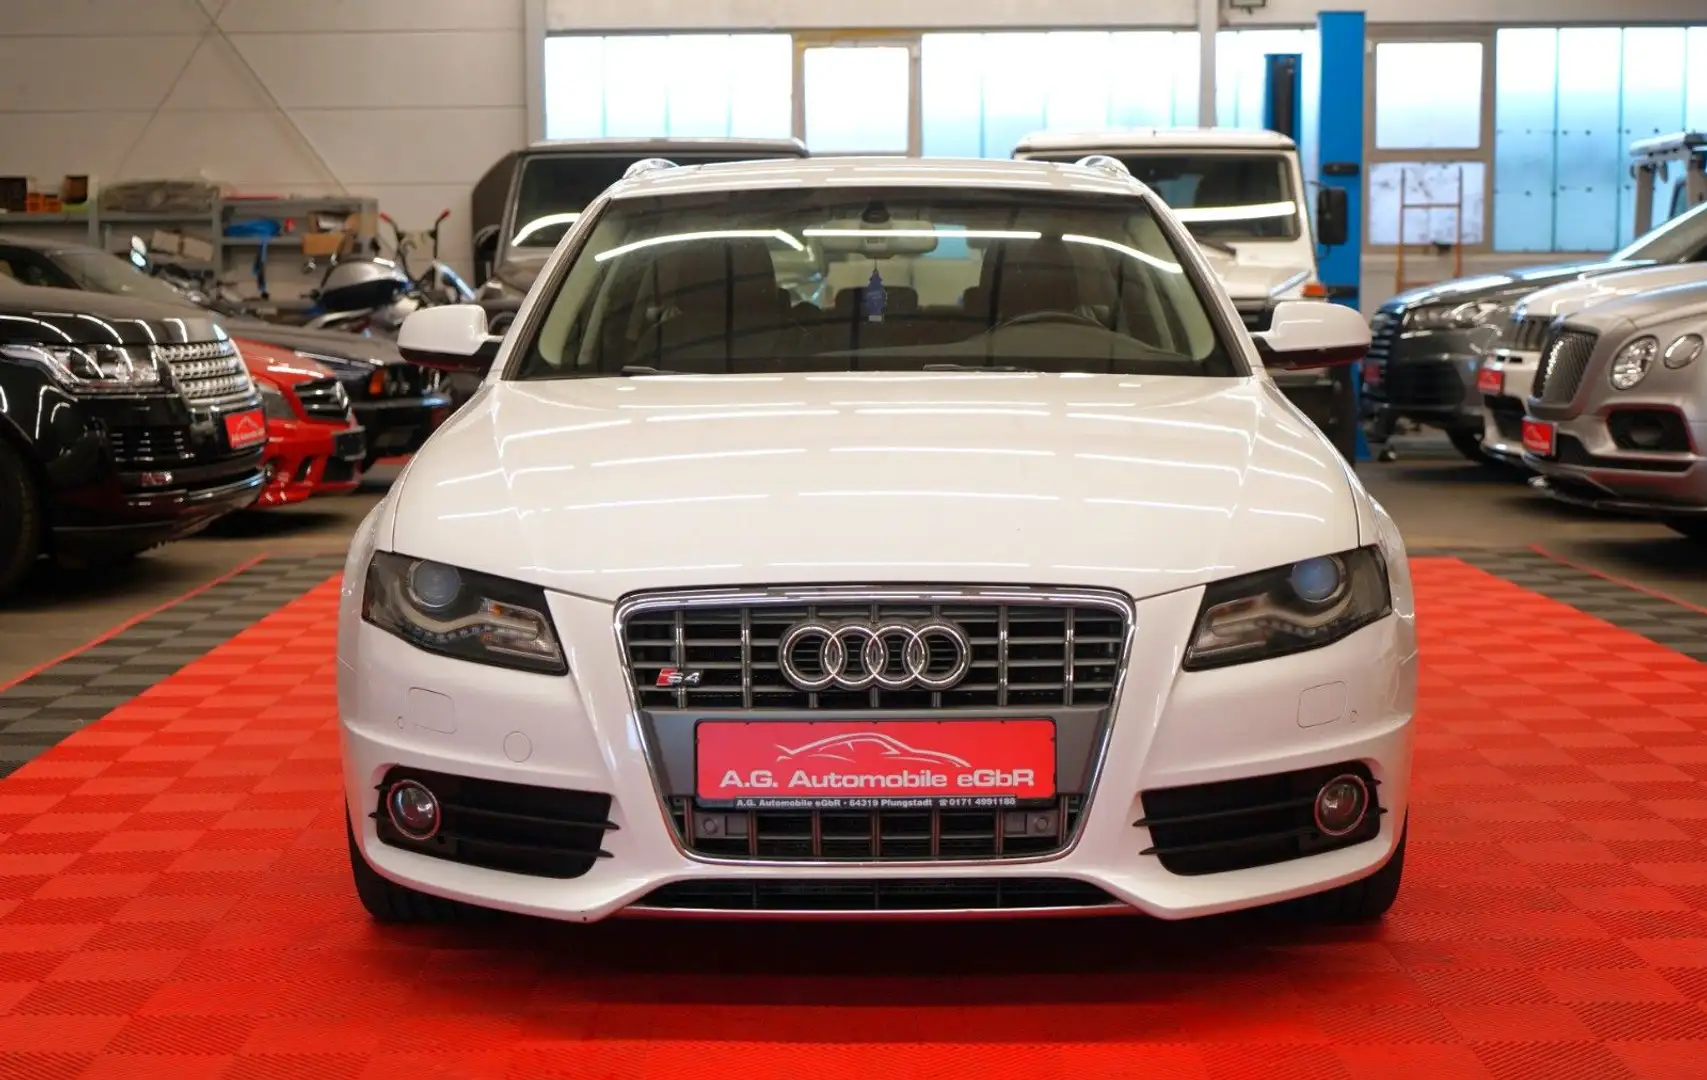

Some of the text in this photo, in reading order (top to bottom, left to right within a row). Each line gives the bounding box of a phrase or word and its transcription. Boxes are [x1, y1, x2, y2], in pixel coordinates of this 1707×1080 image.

[719, 769, 1034, 788] A.G. Automobile eGbR
[736, 799, 756, 808] A.G.
[759, 799, 813, 808] Automobile
[815, 799, 841, 808] eGbR
